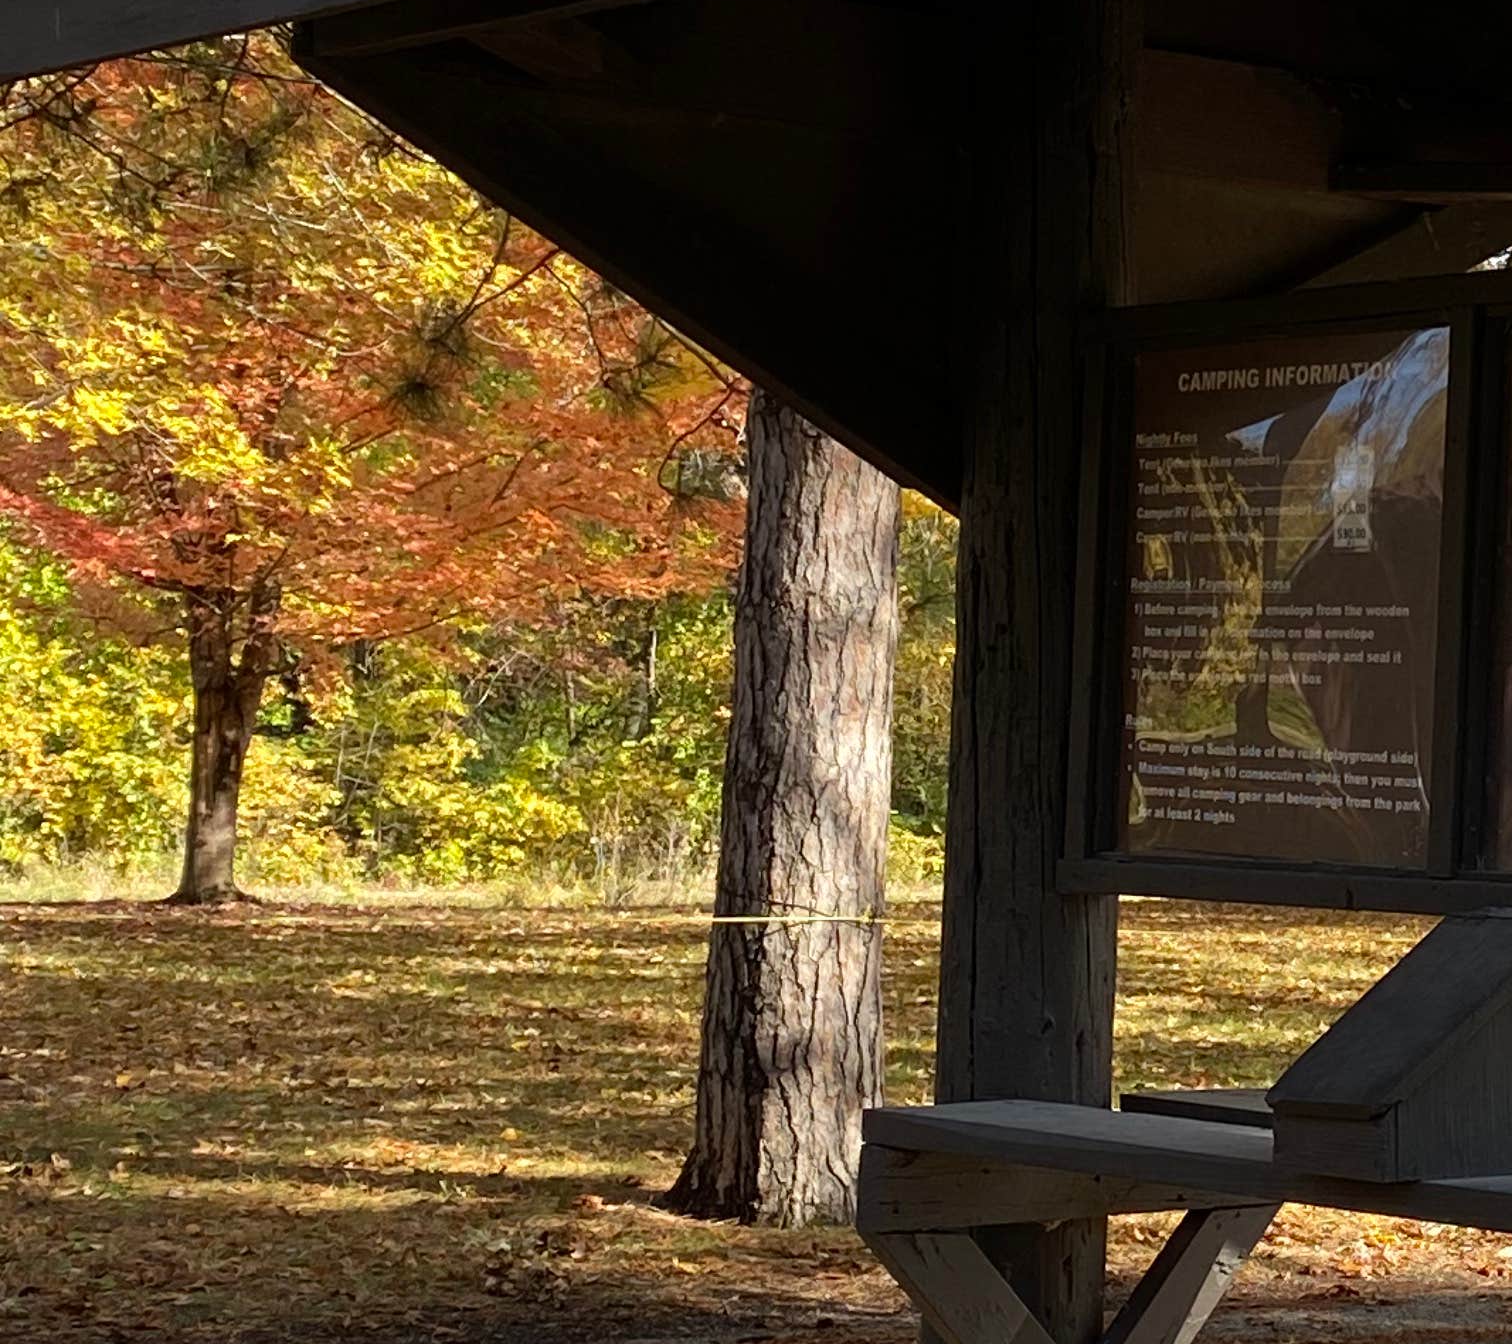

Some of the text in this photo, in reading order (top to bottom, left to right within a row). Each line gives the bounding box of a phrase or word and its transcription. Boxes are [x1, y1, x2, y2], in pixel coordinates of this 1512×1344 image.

[1178, 368, 1260, 392] CAMPING
[1136, 432, 1198, 447] Nightly Fees
[1131, 577, 1191, 592] Registration
[1144, 602, 1175, 615] Before
[1265, 605, 1314, 619] envelope
[1316, 602, 1342, 616] from
[1344, 604, 1363, 616] the
[1365, 604, 1410, 617] wooden
[1144, 625, 1162, 637] box
[1163, 625, 1182, 638] and
[1287, 628, 1302, 639] on
[1304, 627, 1322, 639] the
[1325, 628, 1375, 642] envelope
[1142, 646, 1169, 660] Place
[1272, 648, 1289, 661] the
[1292, 650, 1340, 665] envelope
[1343, 650, 1364, 663] and
[1366, 650, 1390, 663] seal
[1392, 650, 1402, 664] it
[1249, 671, 1266, 684] red
[1301, 673, 1322, 685] box
[1138, 740, 1418, 767] Camp only on South side of the road (playground side)
[1138, 761, 1185, 776] Maximum
[1187, 764, 1209, 780] stay
[1210, 765, 1221, 778] is
[1224, 766, 1237, 779] 10
[1238, 767, 1304, 782] consecutive
[1344, 773, 1369, 786] then
[1371, 776, 1392, 789] you
[1177, 786, 1190, 799] all
[1192, 787, 1237, 803] camping
[1238, 790, 1262, 804] gear
[1264, 790, 1285, 804] and
[1286, 791, 1344, 809] belongings
[1345, 794, 1371, 809] from
[1374, 796, 1393, 810] the
[1394, 797, 1421, 814] park
[1153, 806, 1165, 818] at
[1166, 805, 1192, 821] least
[1193, 807, 1201, 821] 2
[1203, 809, 1236, 824] nights
